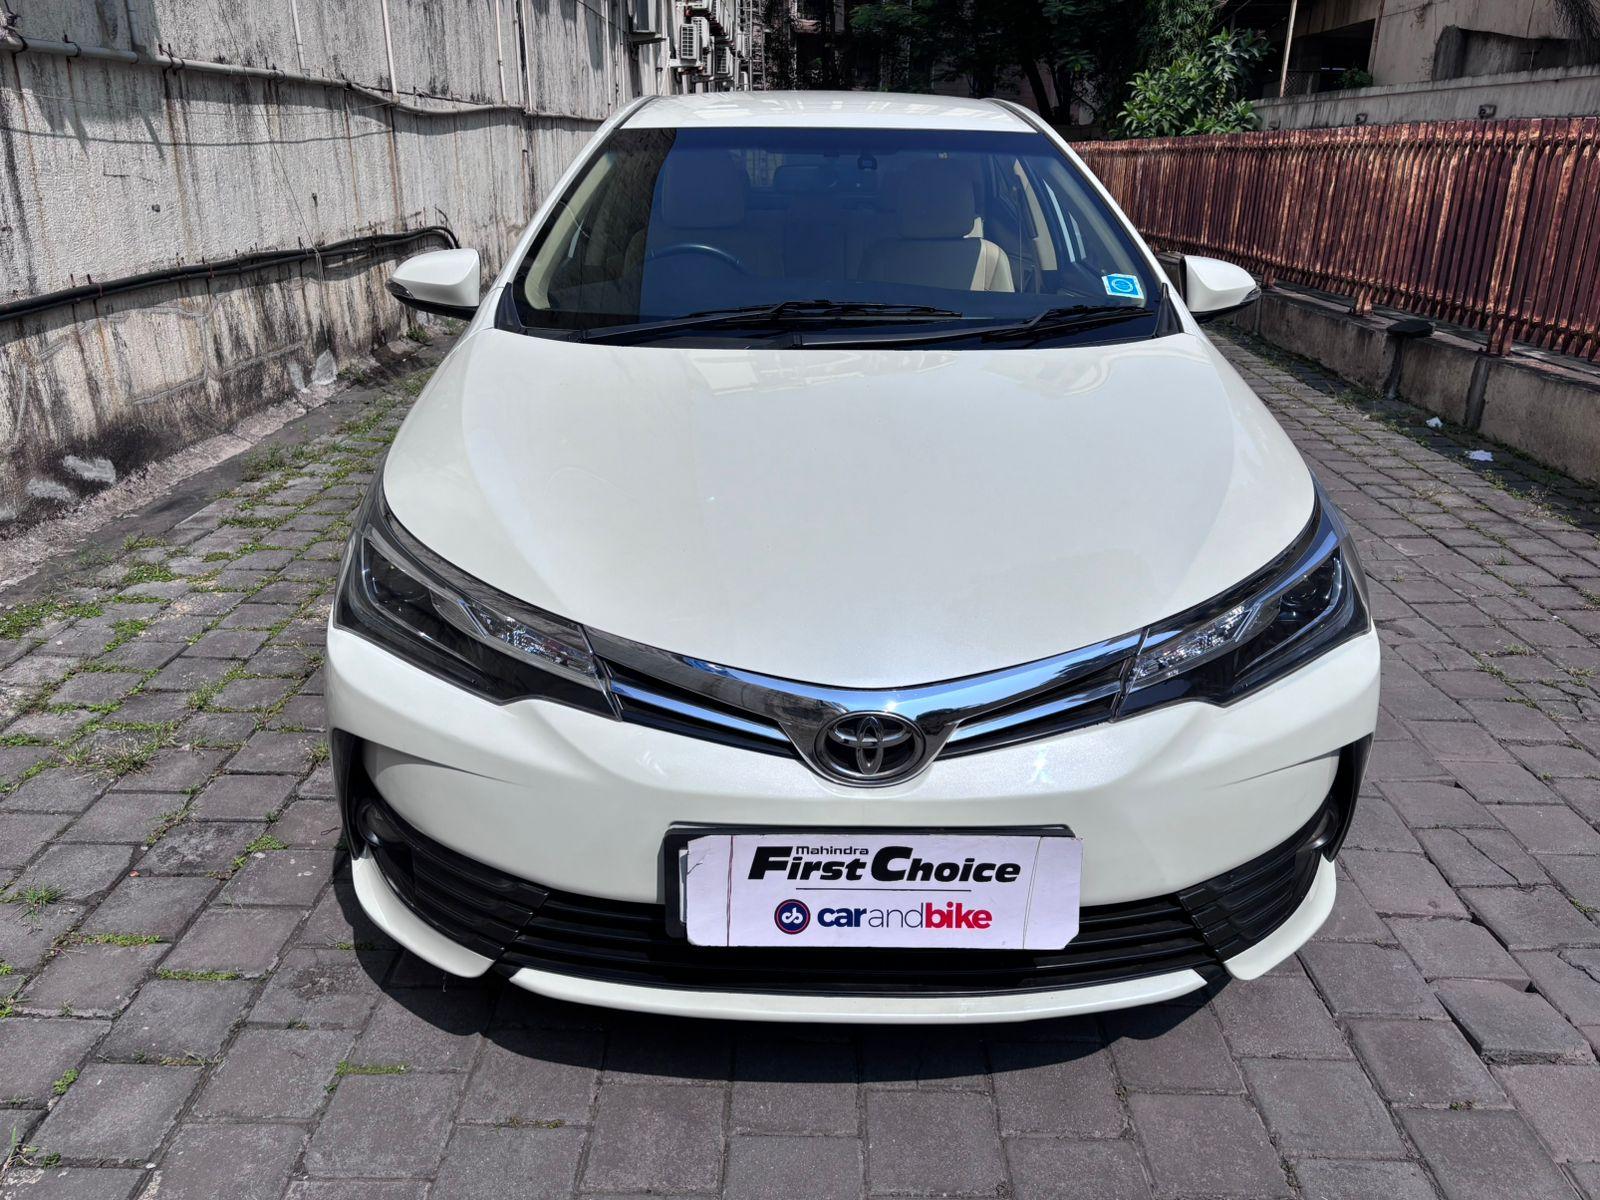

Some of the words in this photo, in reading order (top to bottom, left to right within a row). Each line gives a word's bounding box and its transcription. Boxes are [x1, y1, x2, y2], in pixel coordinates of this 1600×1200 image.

[747, 846, 868, 881] First
[870, 845, 1021, 883] Choice
[795, 845, 869, 855] Mahindra
[817, 901, 993, 929] carandbike
